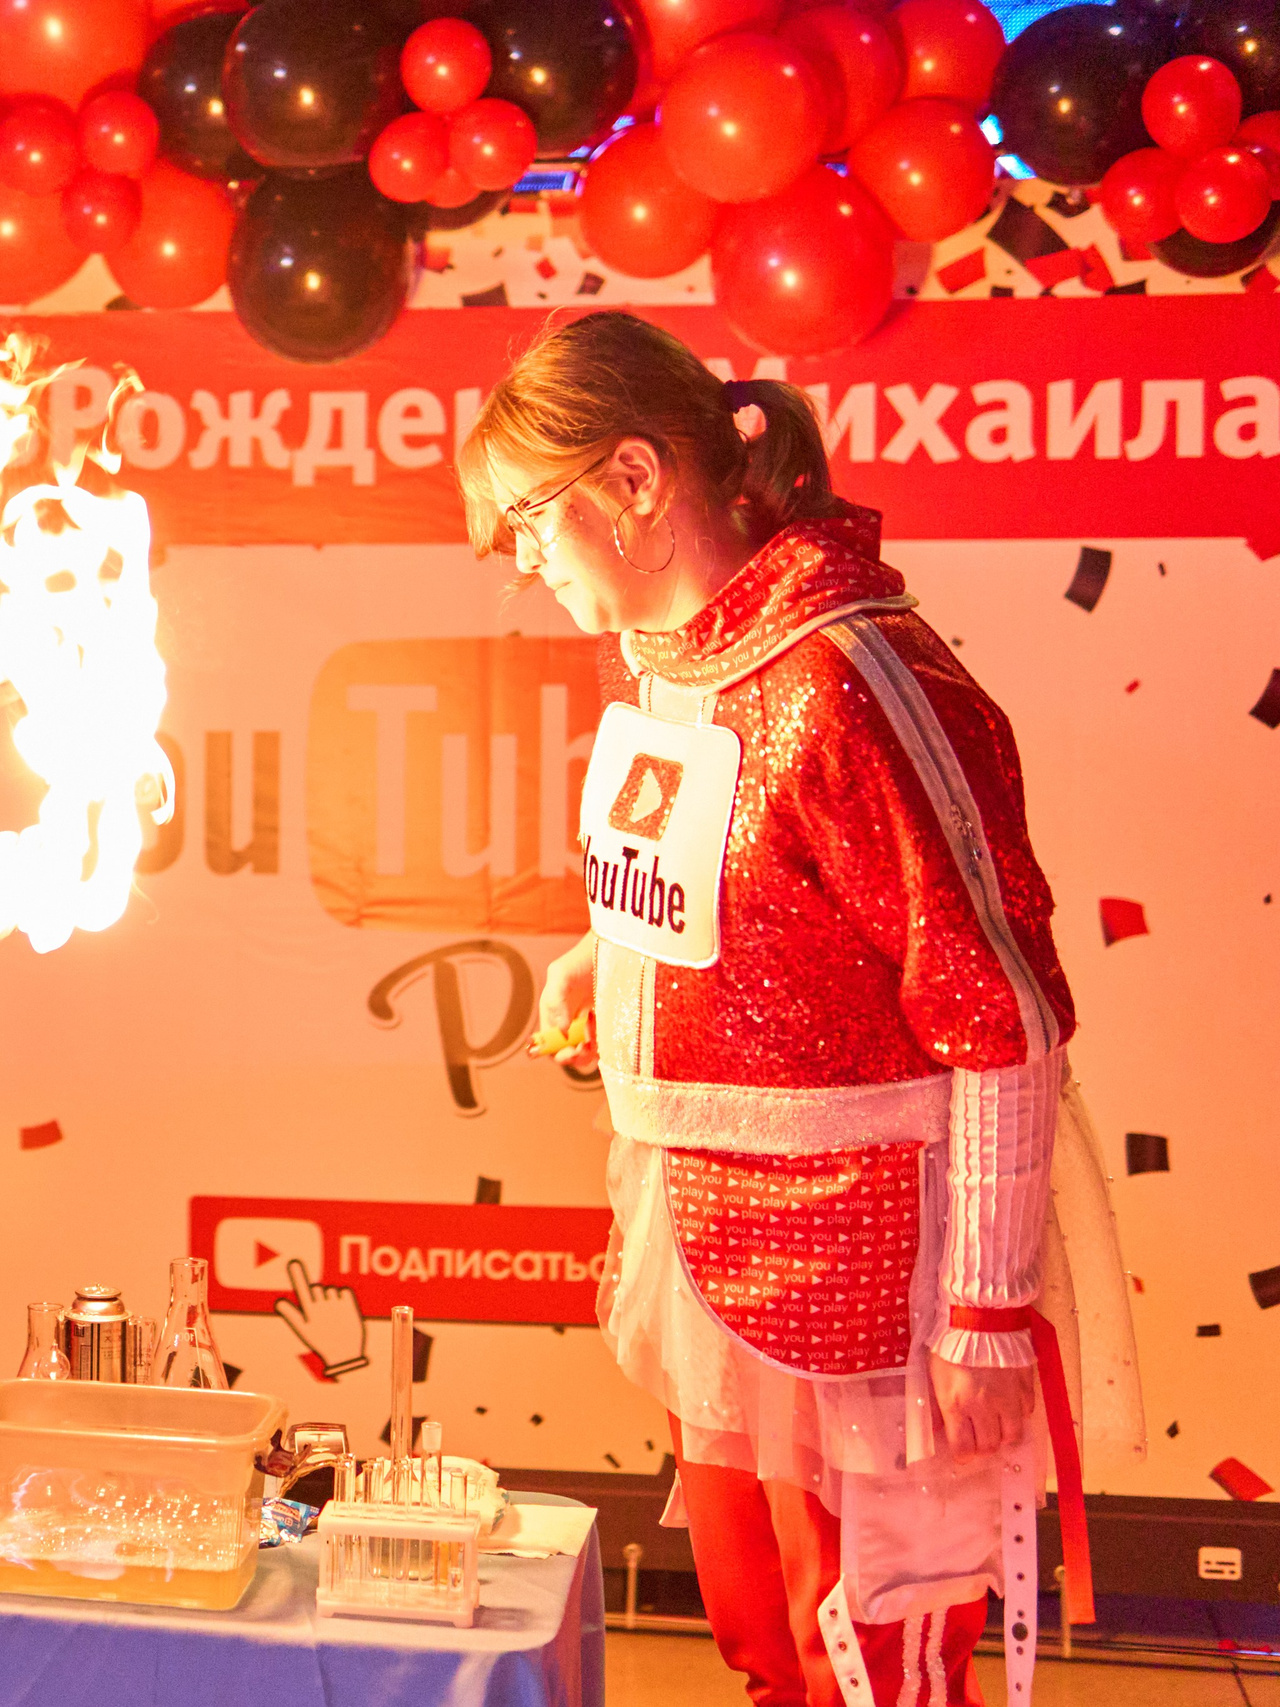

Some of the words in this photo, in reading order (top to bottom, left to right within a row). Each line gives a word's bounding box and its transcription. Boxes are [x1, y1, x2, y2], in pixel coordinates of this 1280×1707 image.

[683, 1156, 707, 1171] play
[726, 1166, 748, 1177] you
[767, 1172, 791, 1184] play
[811, 1175, 832, 1186] you
[851, 1171, 874, 1181] play
[827, 1156, 851, 1167] play
[877, 1154, 898, 1166] you
[701, 1174, 722, 1185] you
[740, 1178, 766, 1192] play
[784, 1186, 808, 1197] you
[825, 1184, 850, 1195] play
[875, 1183, 895, 1195] you
[681, 1186, 704, 1201] play
[722, 1194, 744, 1205] you
[762, 1196, 788, 1210] play
[807, 1202, 829, 1212] you
[849, 1199, 874, 1211] play
[899, 1198, 916, 1207] you
[702, 1205, 723, 1217] you
[741, 1209, 766, 1222] play
[785, 1216, 807, 1226] you
[827, 1214, 852, 1227] play
[878, 1215, 898, 1226] you
[682, 1217, 705, 1232] play
[725, 1225, 747, 1235] you
[765, 1227, 790, 1240] play
[809, 1233, 832, 1243] you
[851, 1230, 876, 1243] play
[701, 1235, 722, 1246] you
[741, 1237, 765, 1250] play
[786, 1243, 807, 1253] you
[826, 1243, 852, 1256] play
[877, 1243, 896, 1255] you
[339, 1234, 607, 1283] Подписатьс
[724, 1254, 746, 1264] you
[764, 1254, 790, 1269] play
[809, 1261, 831, 1272] you
[850, 1260, 874, 1271] play
[701, 1263, 722, 1275] you
[741, 1266, 765, 1281] play
[784, 1273, 806, 1285] you
[825, 1273, 850, 1286] play
[875, 1273, 895, 1283] you
[723, 1283, 745, 1294] you
[762, 1285, 787, 1299] play
[807, 1292, 829, 1303] you
[849, 1289, 872, 1300] play
[704, 1294, 720, 1303] ou
[737, 1295, 762, 1309] play
[782, 1303, 804, 1314] you
[823, 1302, 848, 1314] play
[871, 1300, 890, 1312] you
[760, 1316, 785, 1328] play
[805, 1321, 828, 1330] you
[846, 1317, 868, 1329] play
[783, 1334, 805, 1345] you
[824, 1333, 849, 1345] play
[807, 1352, 829, 1360] you
